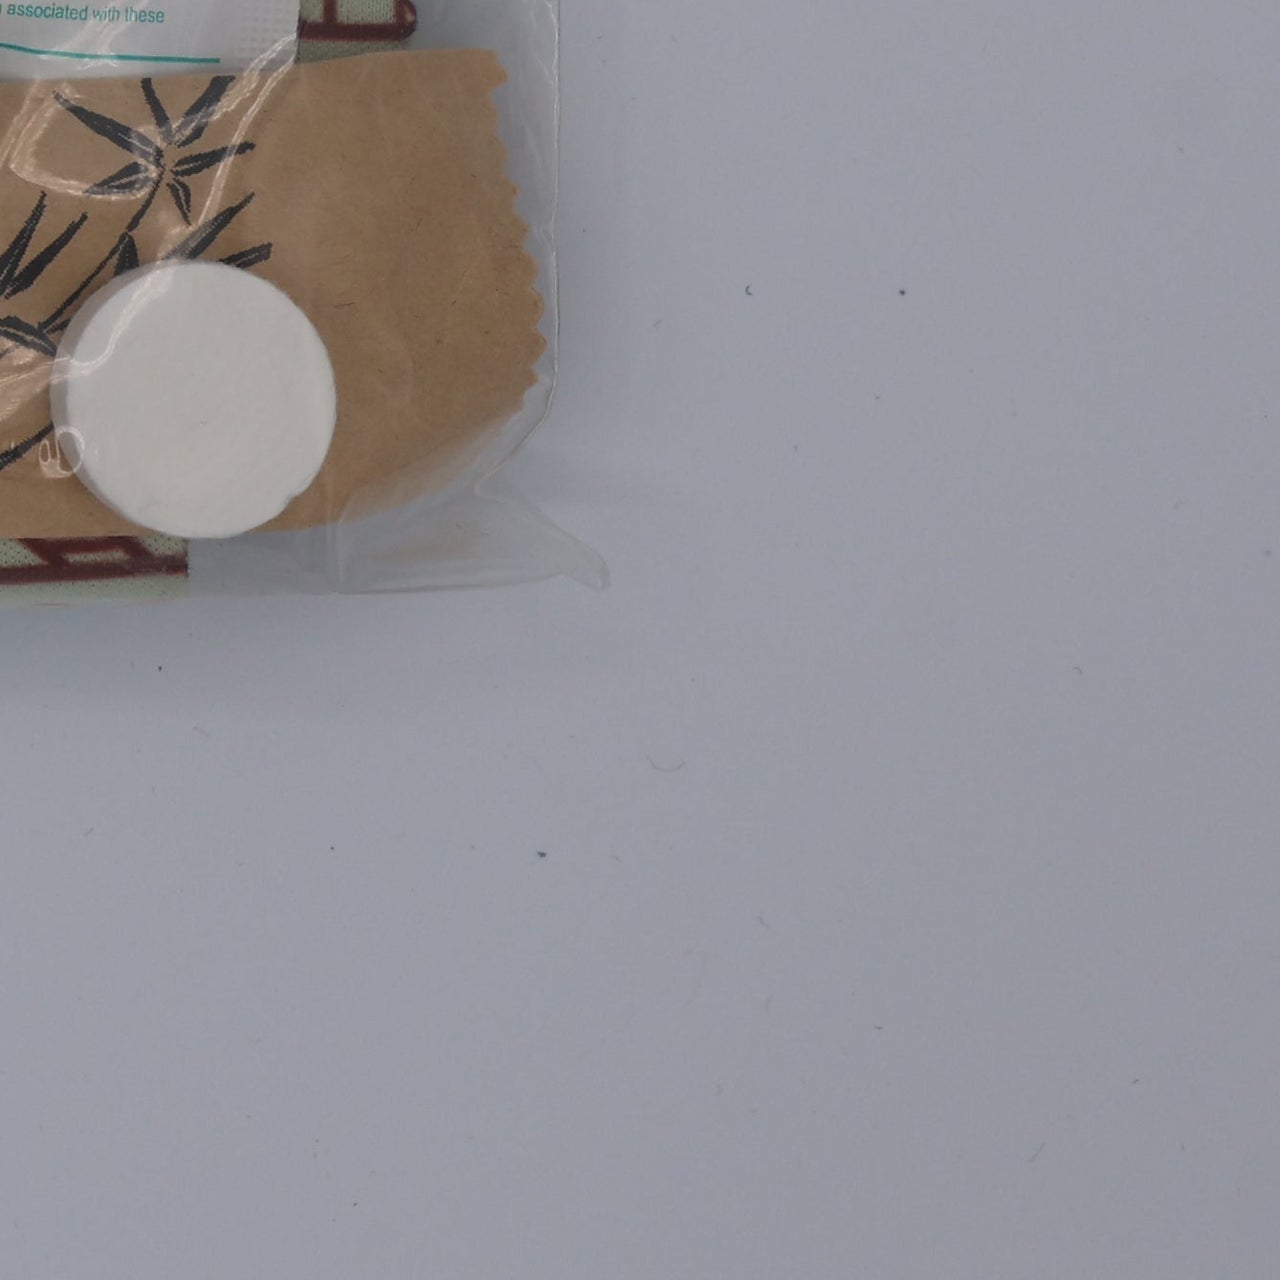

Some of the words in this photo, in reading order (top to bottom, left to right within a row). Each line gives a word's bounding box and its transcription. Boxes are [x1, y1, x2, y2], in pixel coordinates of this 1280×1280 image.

[6, 3, 88, 21] associated
[92, 7, 120, 22] with
[125, 7, 165, 23] these
